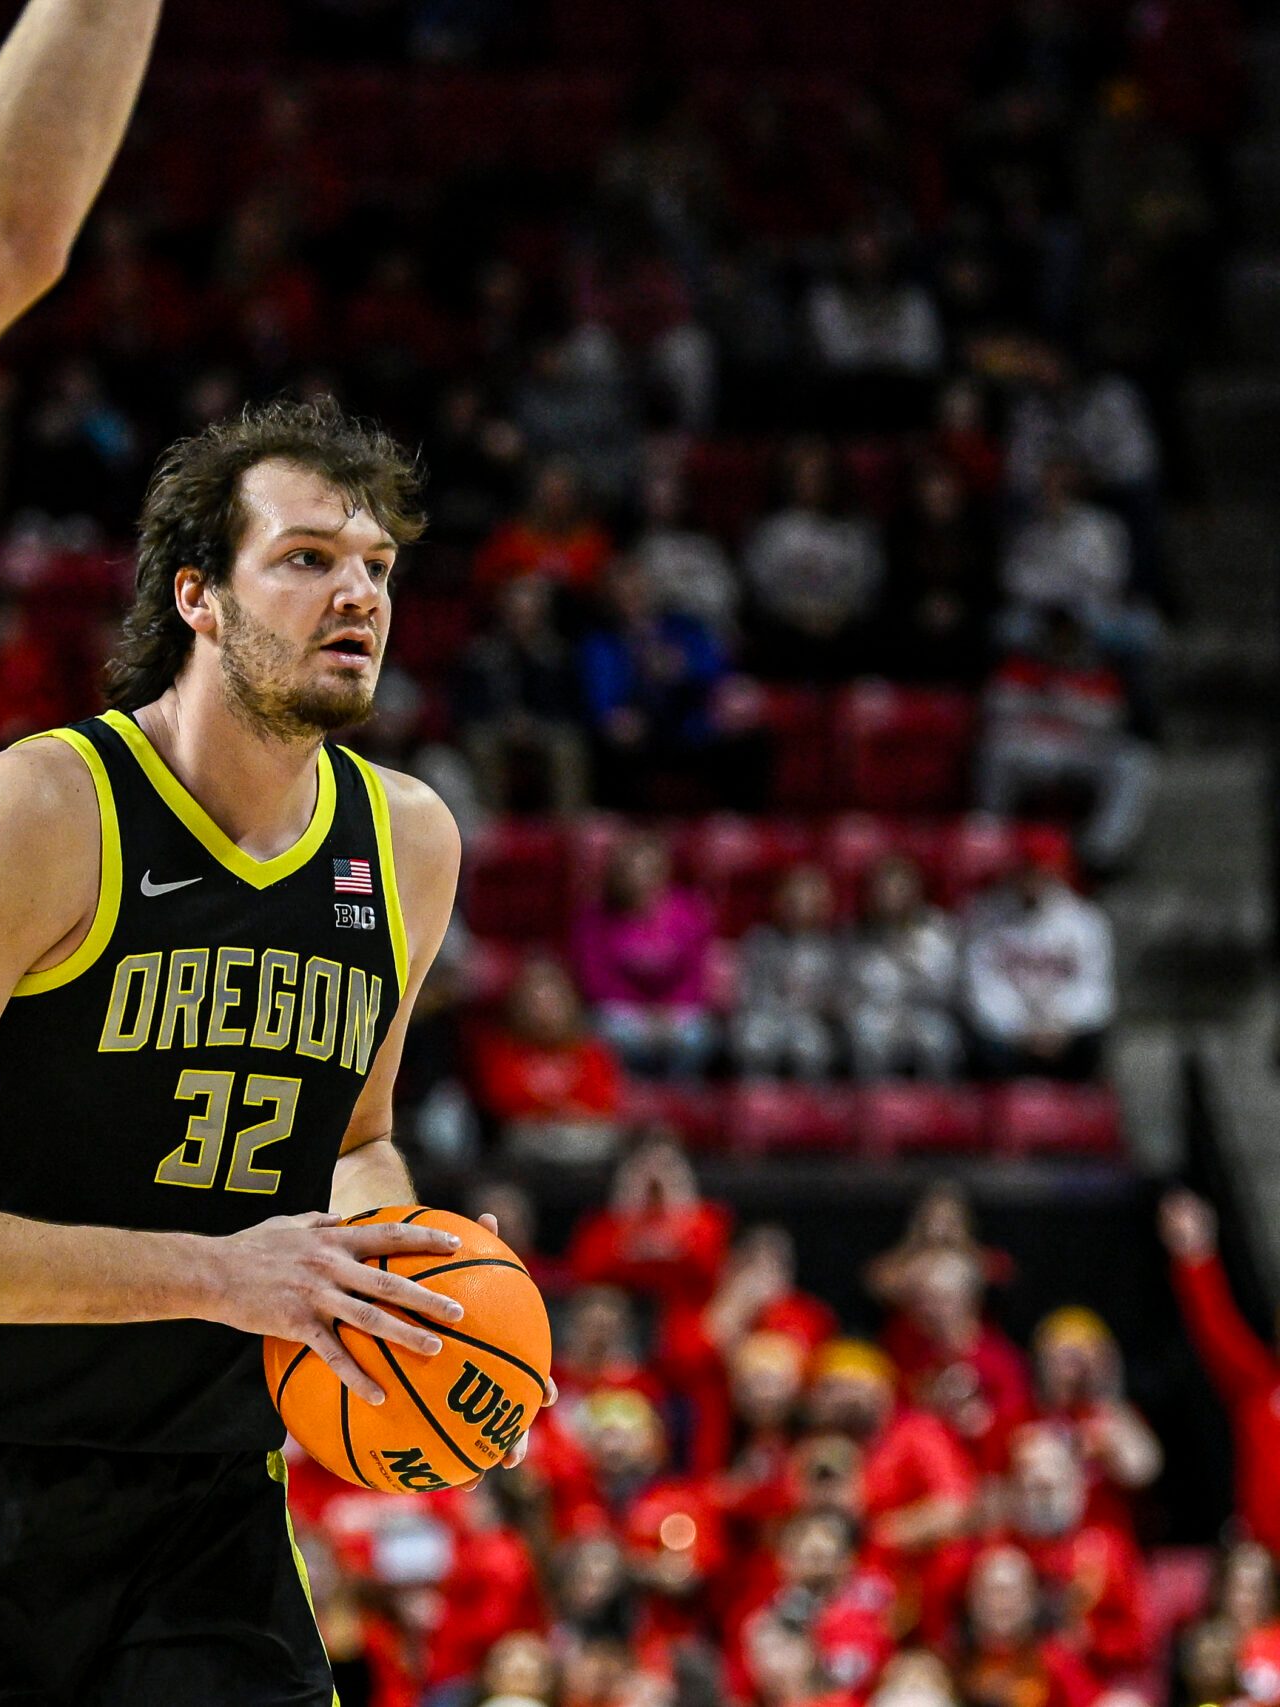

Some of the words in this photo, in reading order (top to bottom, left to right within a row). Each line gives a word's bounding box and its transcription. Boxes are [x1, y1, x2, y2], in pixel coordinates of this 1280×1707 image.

[98, 947, 383, 1076] OREGON
[154, 1069, 302, 1194] 32
[446, 1359, 526, 1456] Wils
